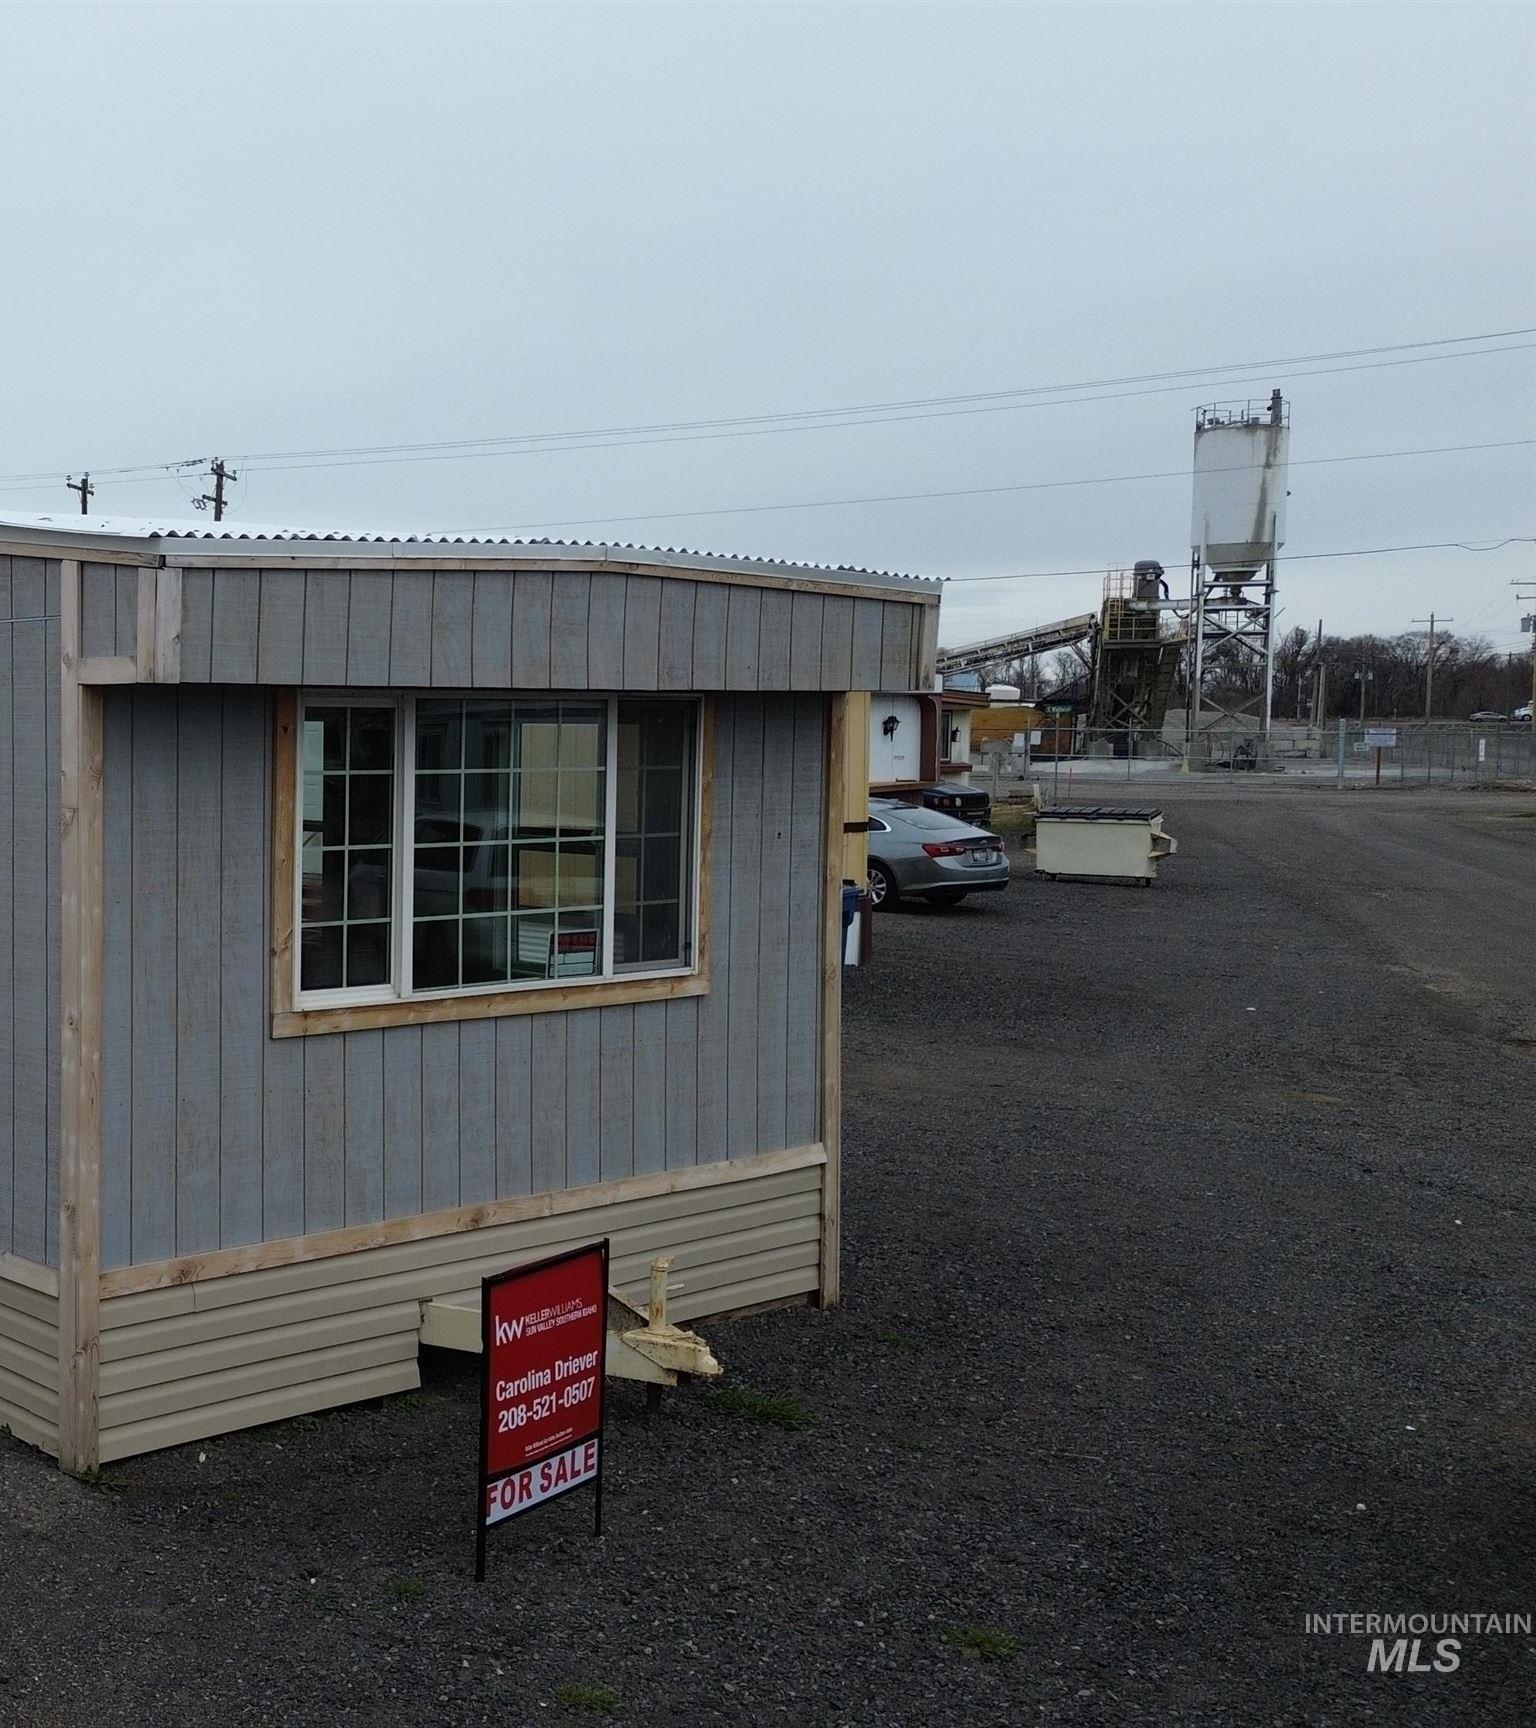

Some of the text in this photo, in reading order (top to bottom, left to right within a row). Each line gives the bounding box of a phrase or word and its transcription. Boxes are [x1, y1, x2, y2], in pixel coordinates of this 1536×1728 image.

[495, 1315, 524, 1346] kw
[525, 1325, 537, 1337] SUN
[537, 1319, 555, 1333] VALLEY
[496, 1350, 598, 1402] Carolina Driever
[498, 1376, 595, 1433] 208-521-0507
[486, 1471, 533, 1519] FOR
[539, 1441, 596, 1493] SALE
